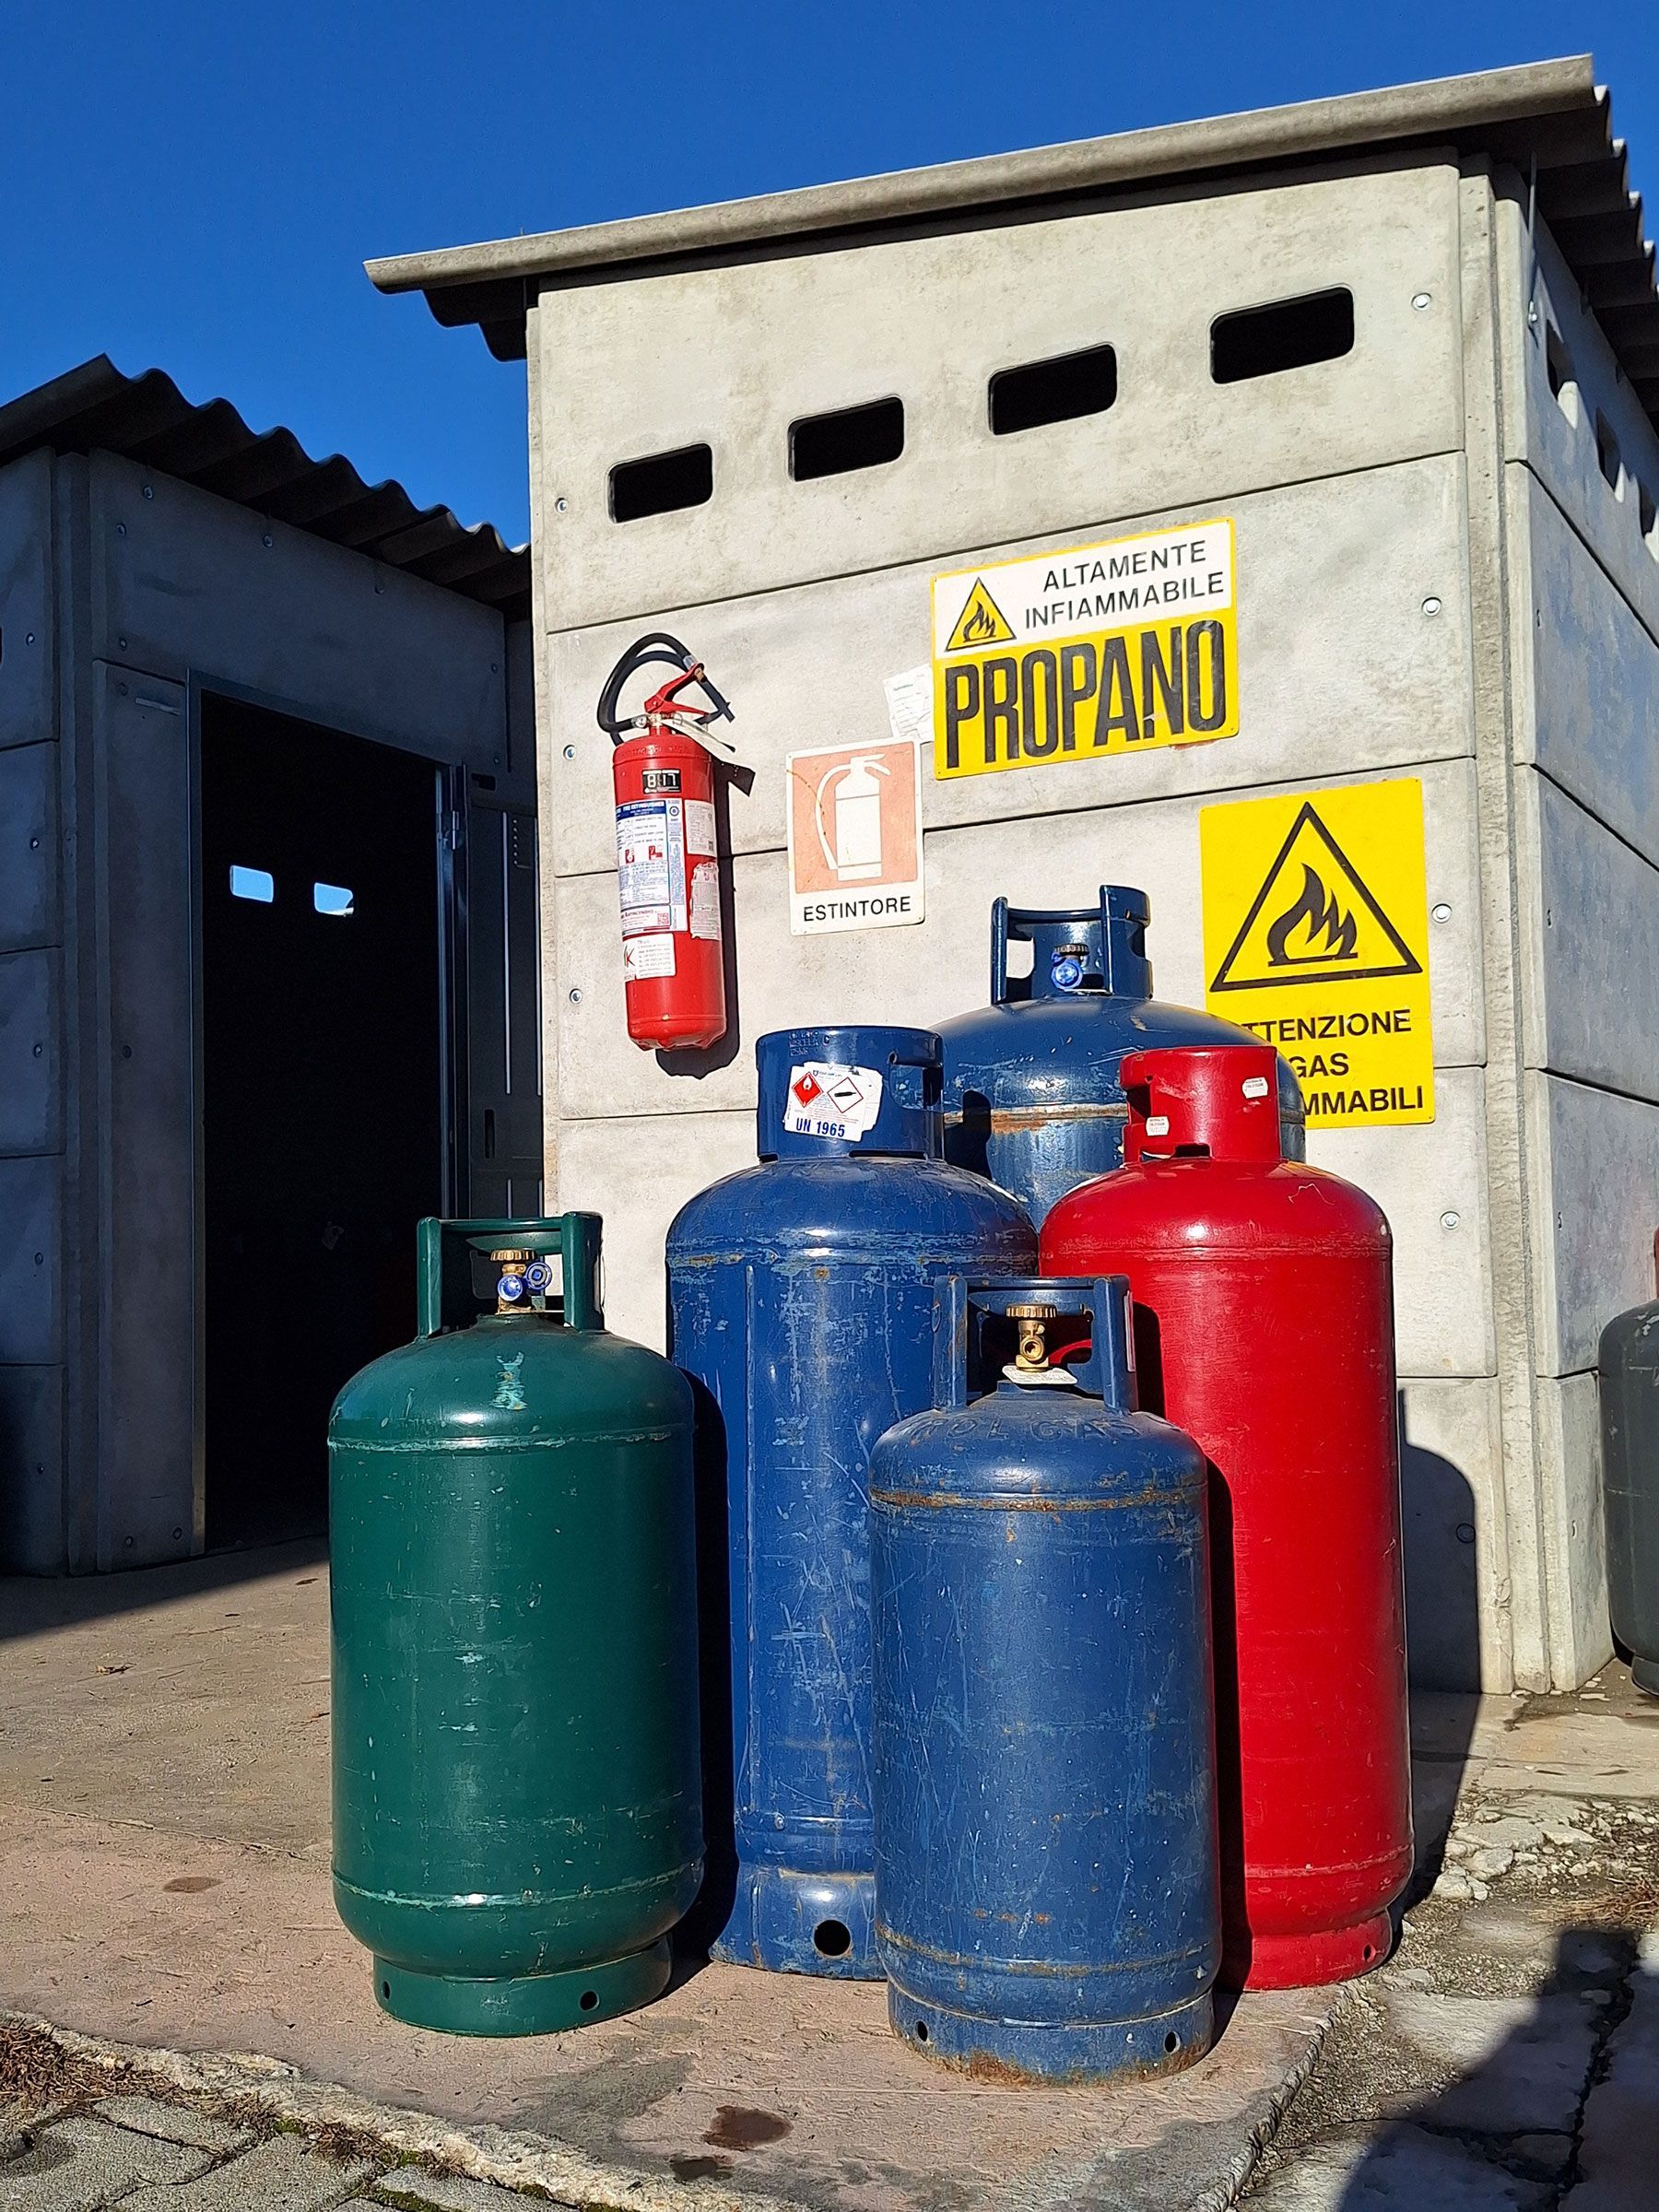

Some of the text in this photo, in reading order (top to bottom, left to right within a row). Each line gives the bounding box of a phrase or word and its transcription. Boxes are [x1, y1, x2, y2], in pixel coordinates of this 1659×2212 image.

[1043, 540, 1206, 593] ALTAMENTE
[1025, 571, 1224, 629] INFIAMMABILE
[945, 619, 1227, 769] PROPANO
[804, 896, 912, 922] ESTINTORE
[1241, 1009, 1411, 1042] TTENZIONE
[1288, 1053, 1349, 1077] GAS
[1300, 1086, 1423, 1116] MMABILI
[795, 1117, 845, 1138] UN 1965
